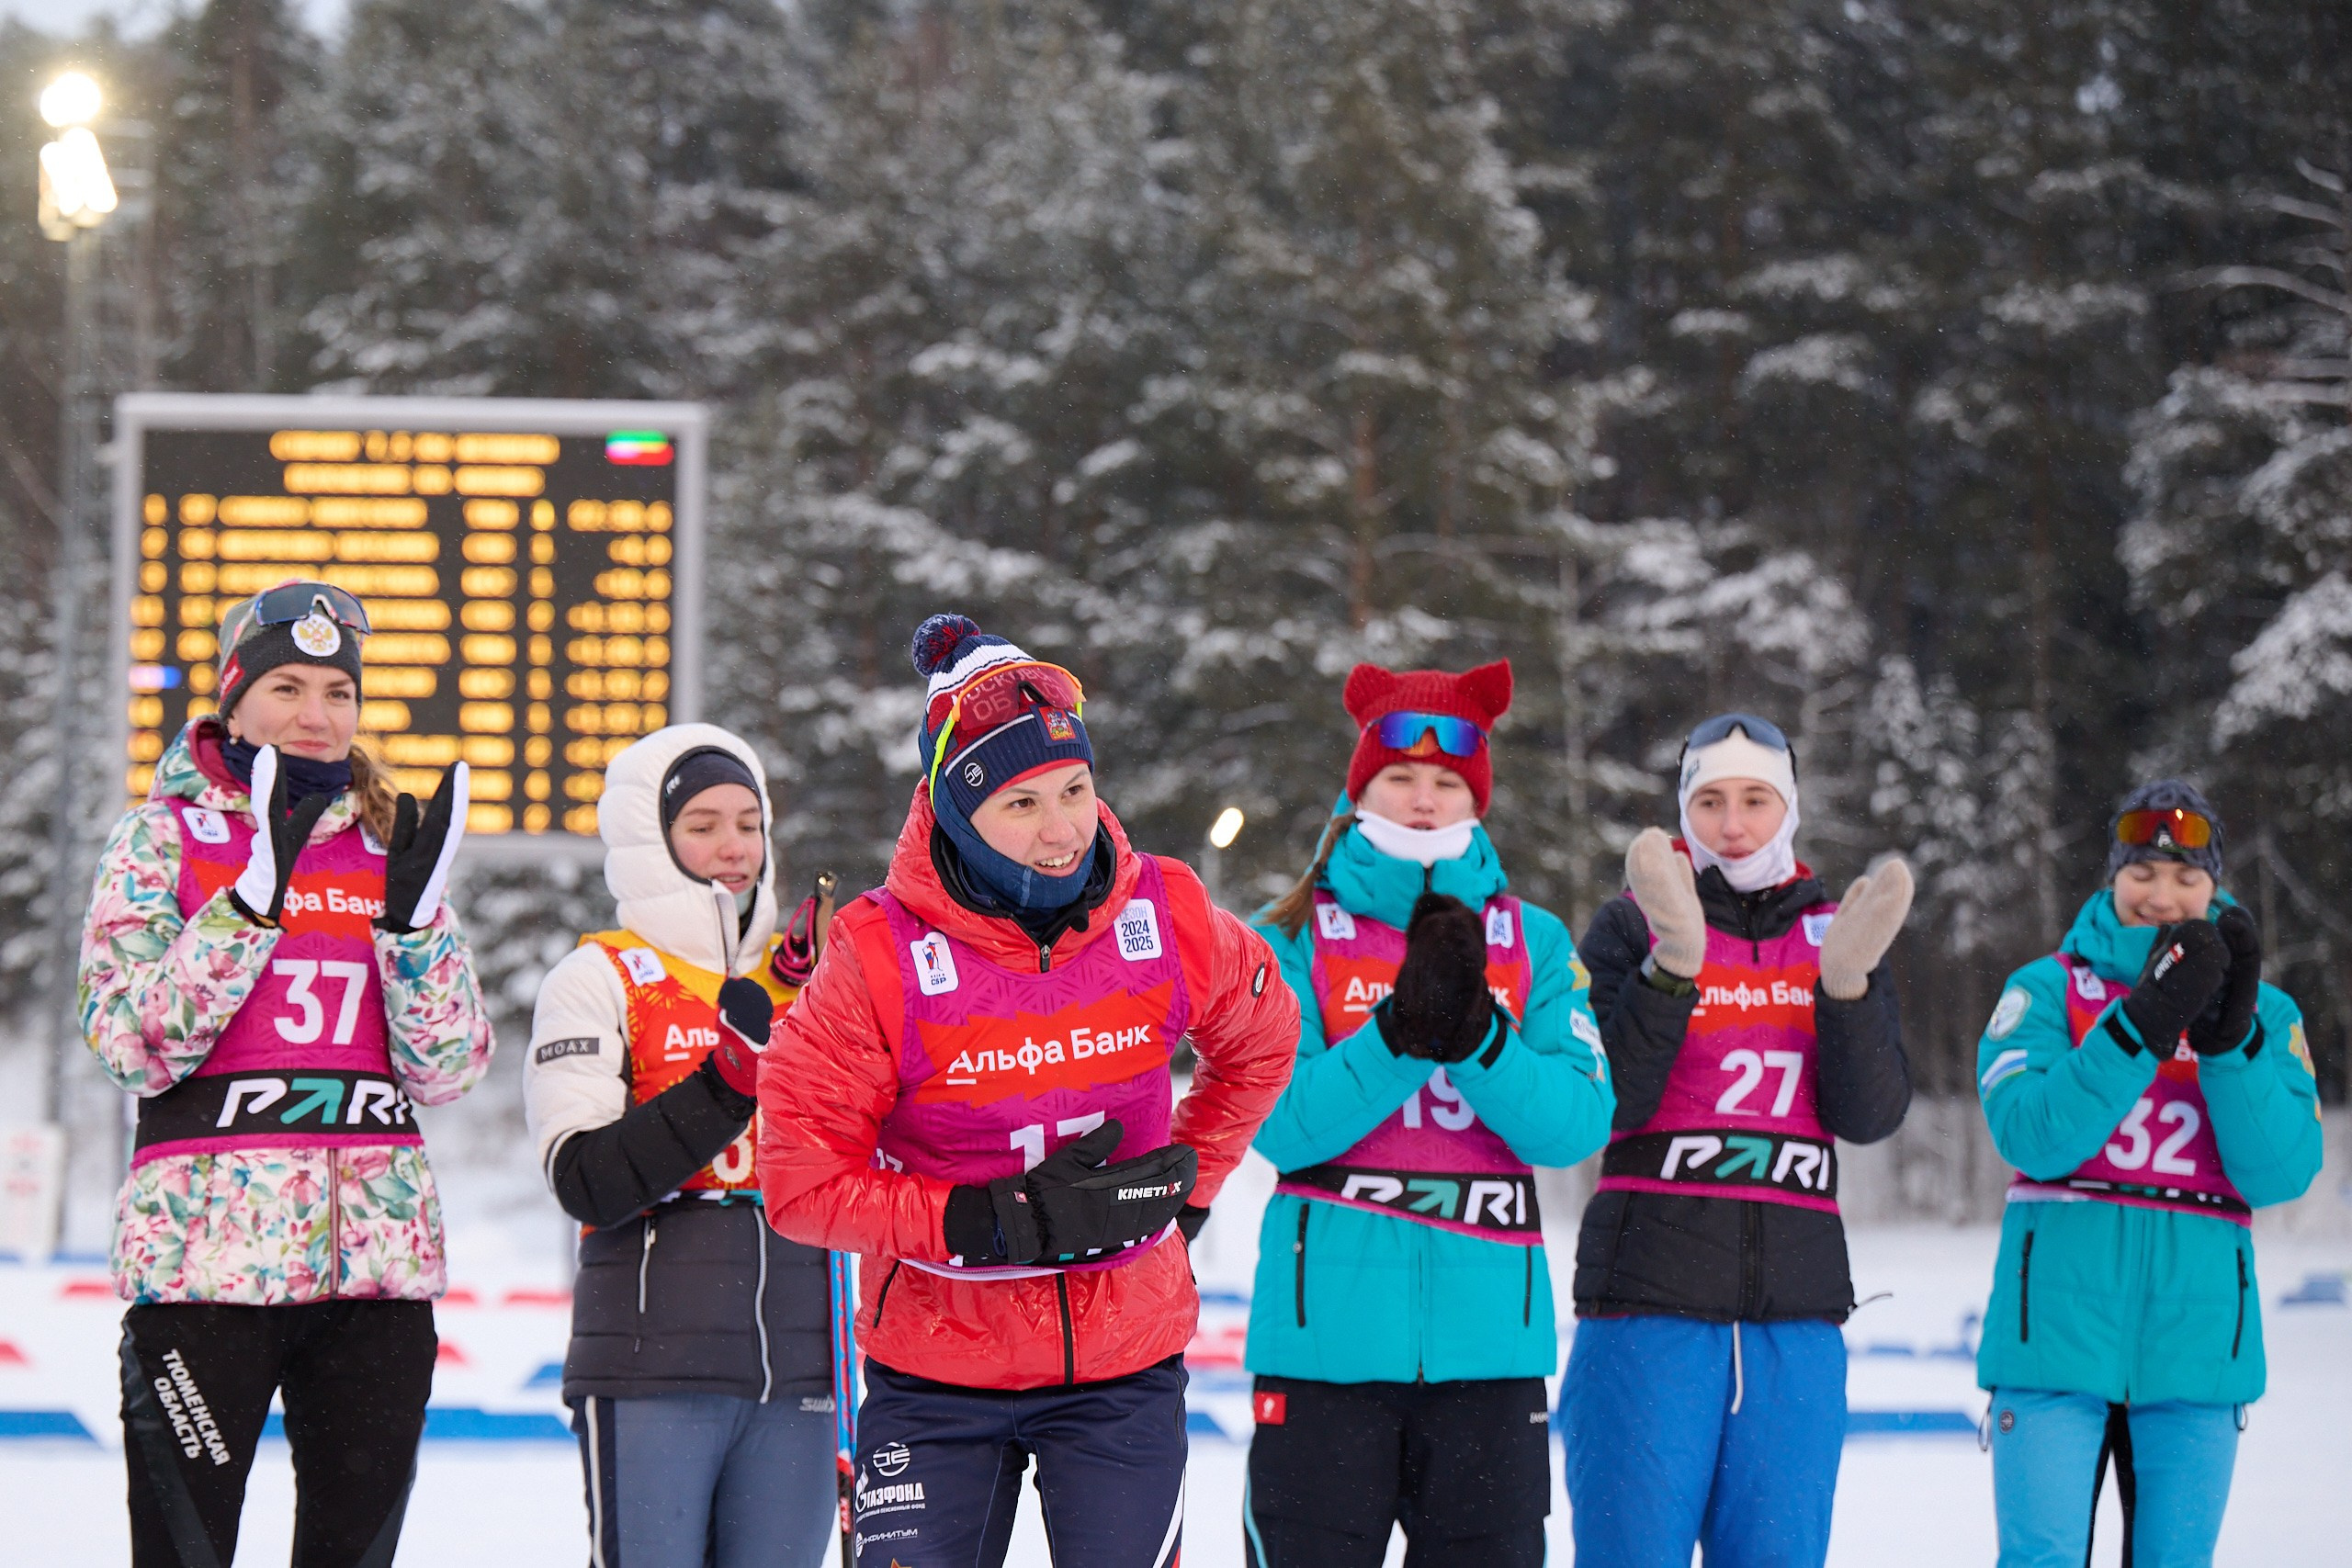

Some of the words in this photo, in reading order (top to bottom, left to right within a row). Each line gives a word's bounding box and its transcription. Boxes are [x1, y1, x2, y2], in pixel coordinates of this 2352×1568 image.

[326, 887, 384, 918] Бан
[1121, 919, 1149, 937] 2024
[1125, 935, 1154, 953] 2025
[272, 959, 368, 1045] 37
[1691, 981, 1769, 1016] льфа
[664, 1024, 720, 1061] Аль
[946, 1036, 1066, 1085] Альфа
[1070, 1024, 1151, 1060] Банк
[1714, 1049, 1804, 1118] 27
[1660, 1134, 1830, 1191] PARI
[2104, 1098, 2200, 1177] 32
[153, 1377, 200, 1461] ОБЛАСТЬ
[162, 1348, 232, 1466] ТЮМЕНСКАЯ
